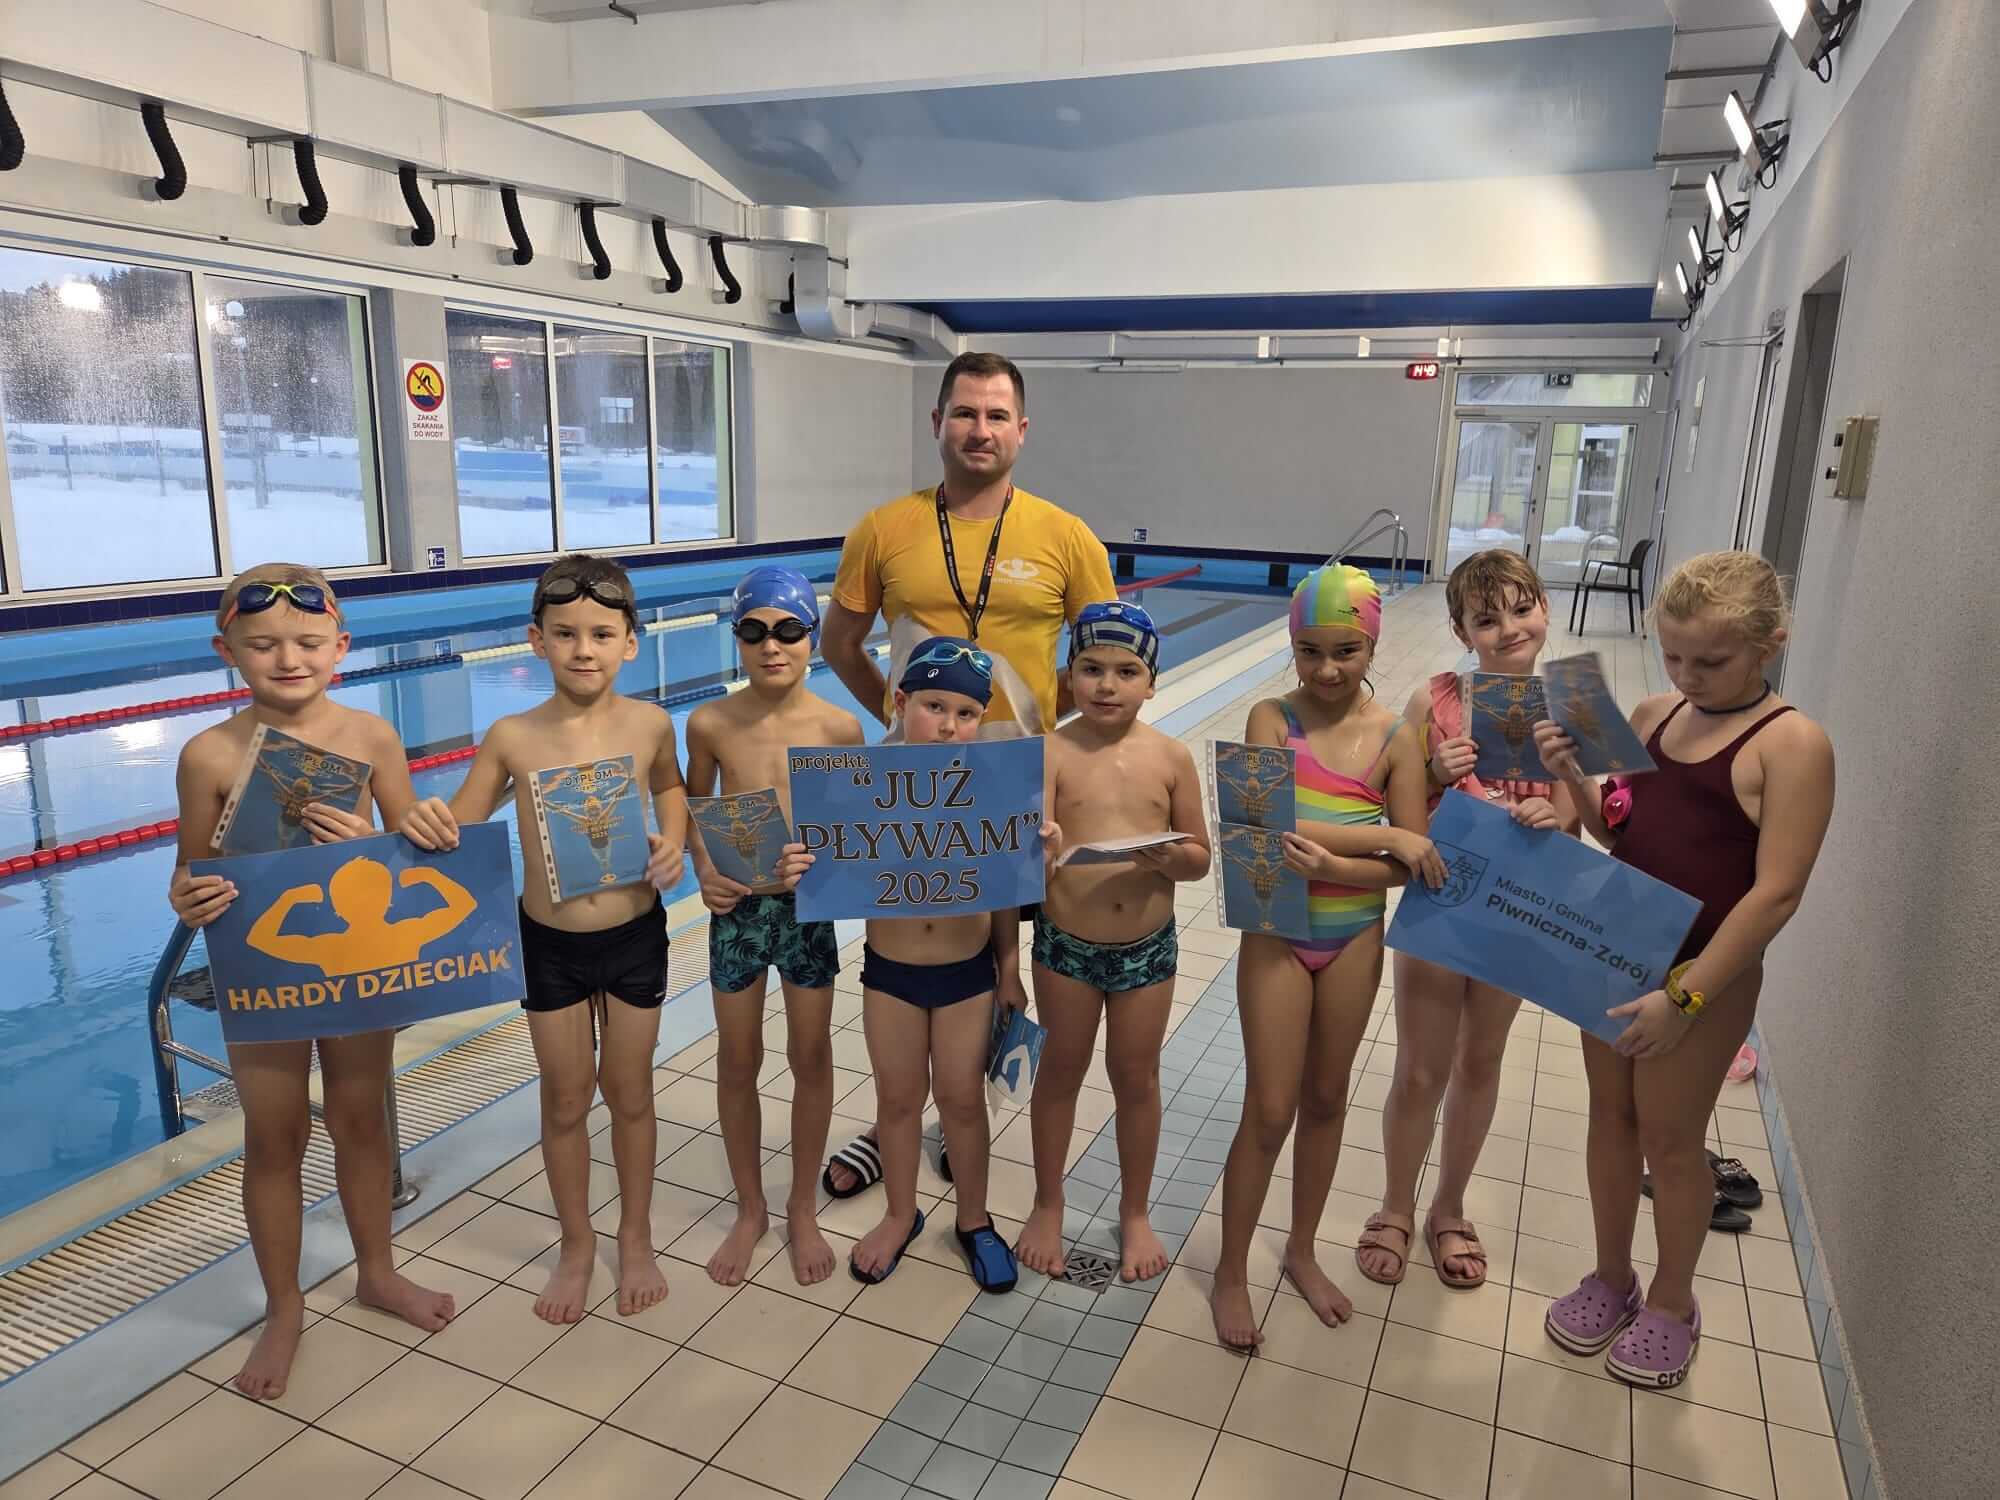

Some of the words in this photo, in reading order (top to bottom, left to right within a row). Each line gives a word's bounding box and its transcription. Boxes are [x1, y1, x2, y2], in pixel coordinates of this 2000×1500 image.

[412, 422, 444, 430] SKAKANIA
[424, 430, 443, 438] WODY
[287, 750, 342, 776] DYPLOM
[791, 752, 871, 774] projekt:
[564, 768, 614, 787] DYPLOM
[875, 866, 982, 906] 2025
[1495, 875, 1547, 907] Miasto
[1555, 903, 1605, 936] Gmina
[1486, 893, 1652, 988] Piwniczna-Zdrój
[227, 978, 347, 1011] HARDY
[356, 947, 512, 999] DZIECIAK
